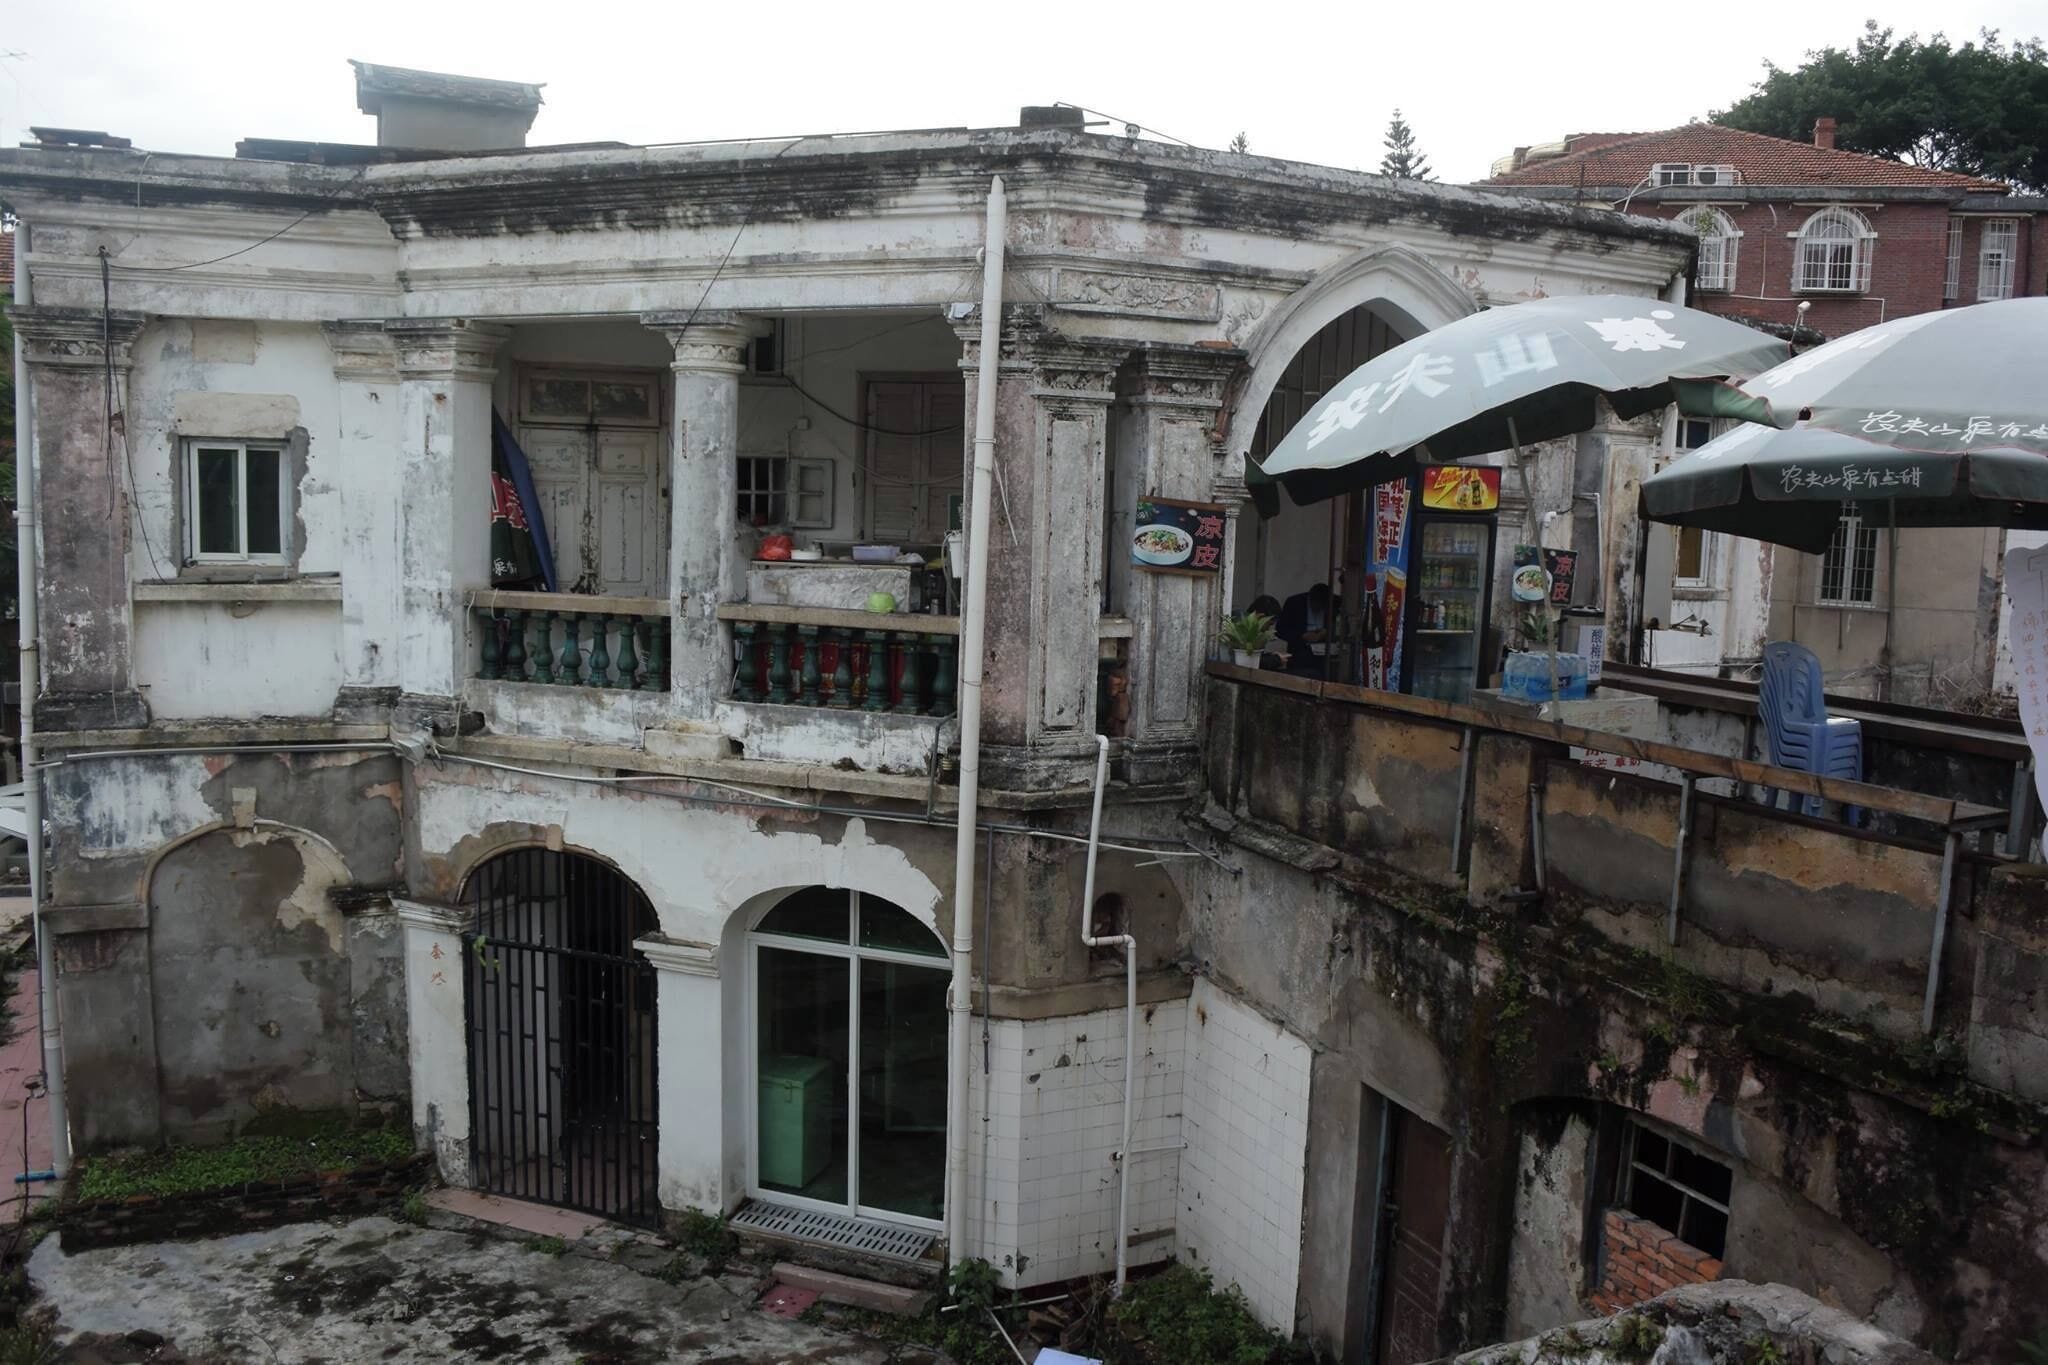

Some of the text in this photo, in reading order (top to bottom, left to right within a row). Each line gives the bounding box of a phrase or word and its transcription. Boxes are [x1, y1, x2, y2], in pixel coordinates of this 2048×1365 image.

[1779, 463, 1924, 494] 农夫山泉有点甜
[1191, 515, 1224, 568] 凉皮
[1376, 484, 1390, 561] 国凉茶
[1551, 554, 1575, 602] 凉皮
